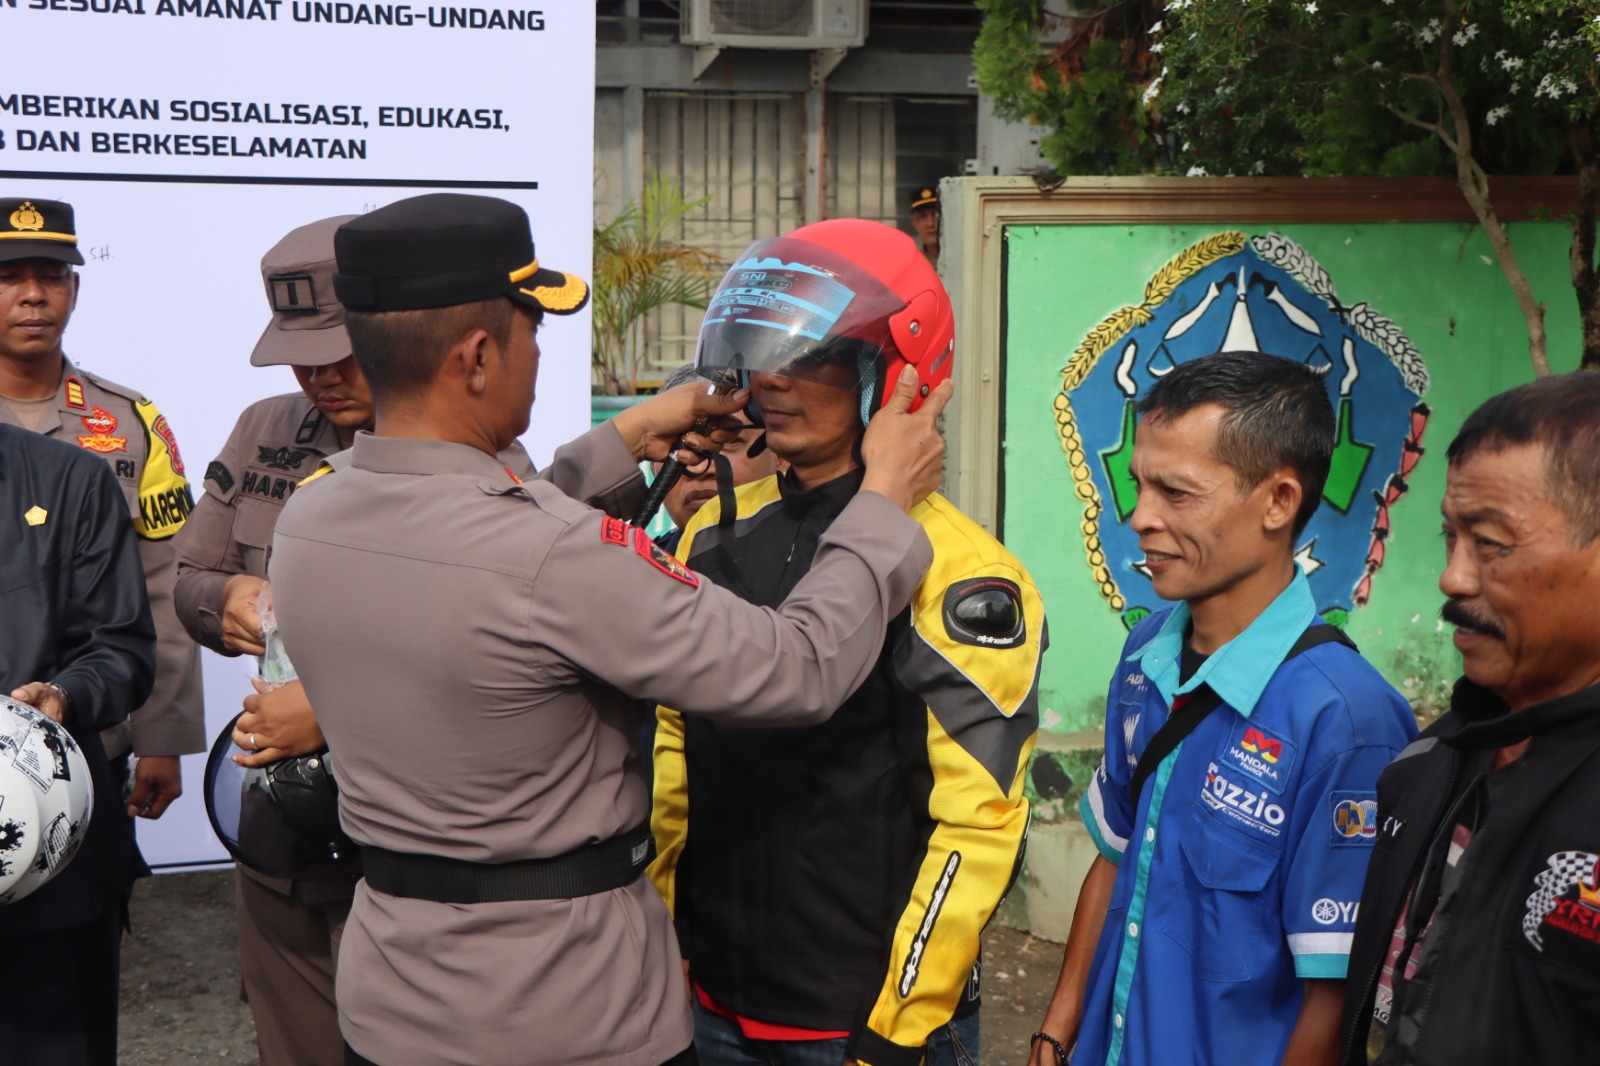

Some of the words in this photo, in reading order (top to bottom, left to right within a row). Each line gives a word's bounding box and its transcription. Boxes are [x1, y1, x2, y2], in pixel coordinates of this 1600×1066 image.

[155, 0, 282, 21] AMANAT
[292, 1, 545, 31] UNDANG-UNDANG
[170, 100, 369, 129] SOSIALISASI,
[378, 106, 510, 132] EDUKASI,
[16, 129, 81, 152] DAN
[91, 132, 367, 160] BERKESELAMATAN
[1230, 747, 1278, 780] MANDALA
